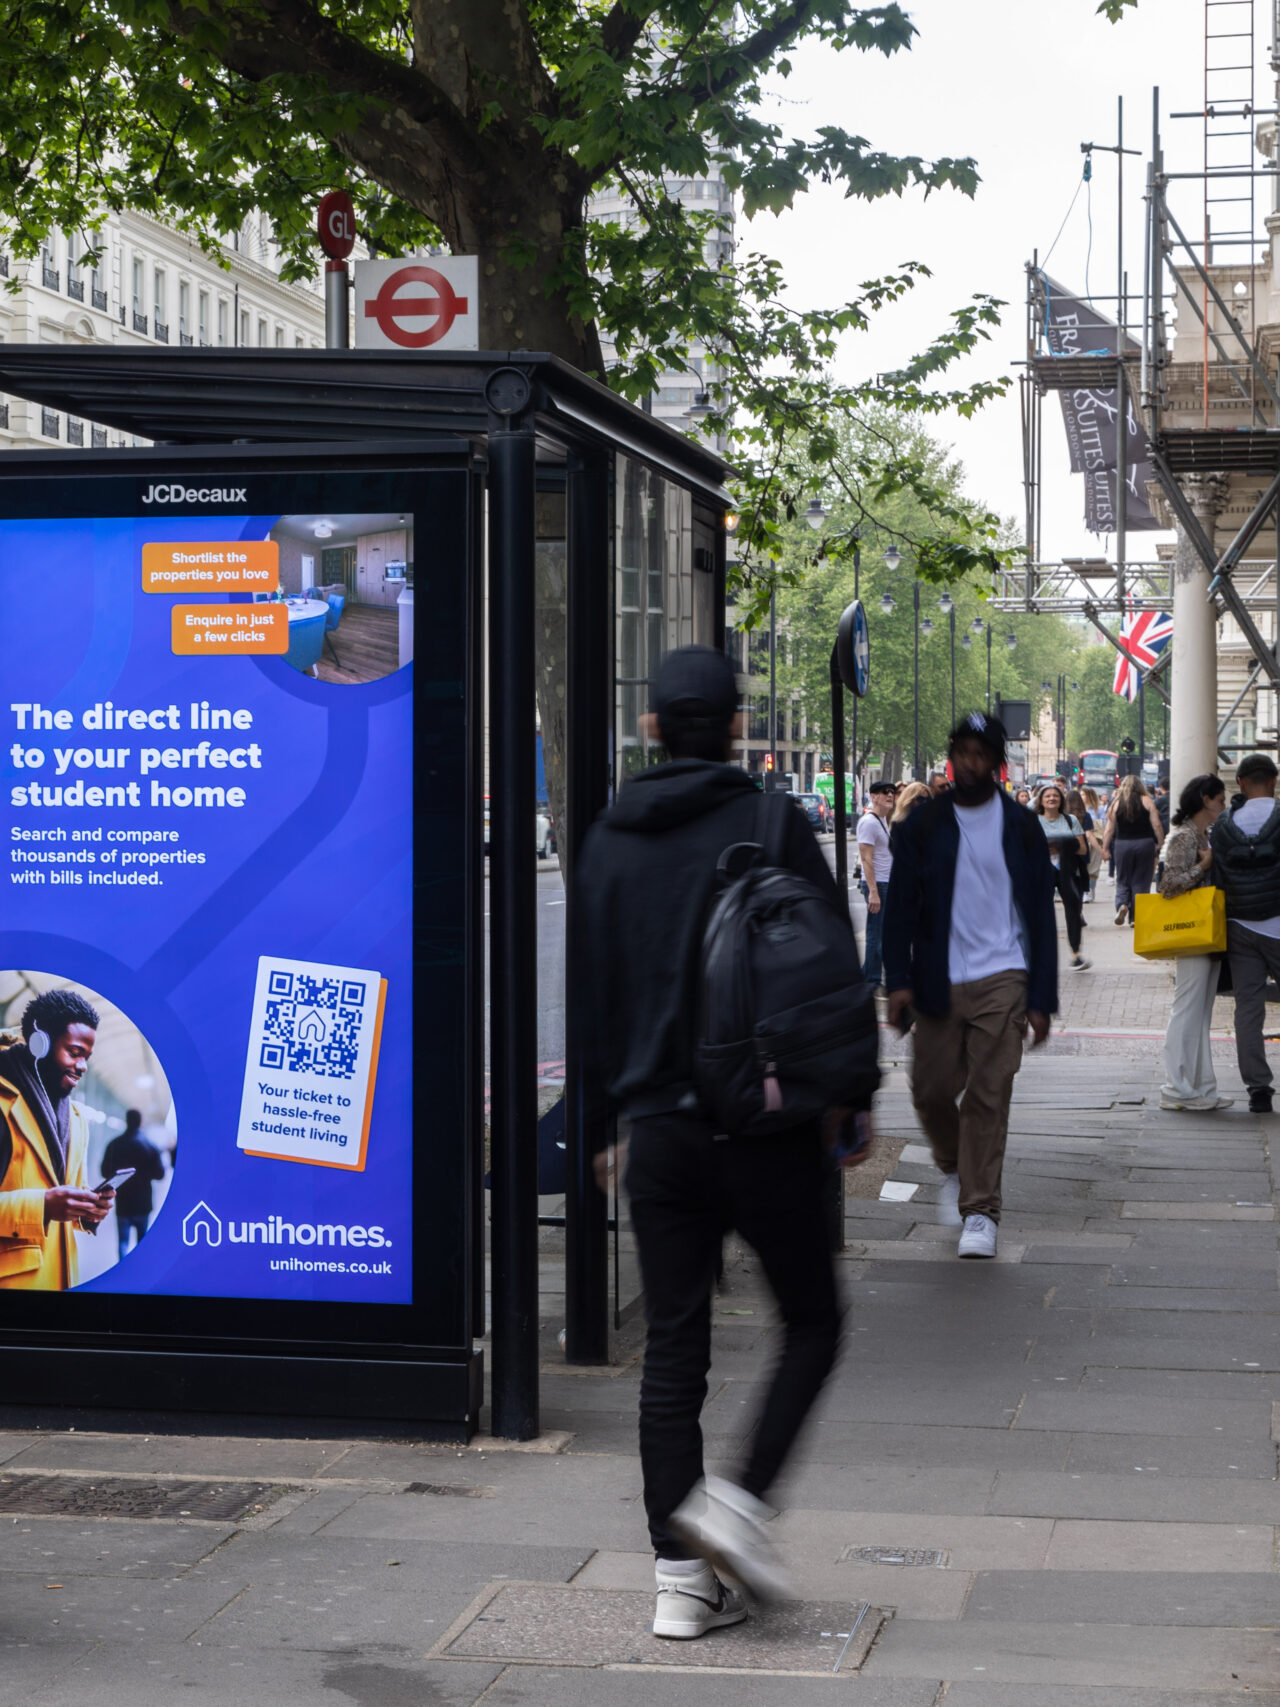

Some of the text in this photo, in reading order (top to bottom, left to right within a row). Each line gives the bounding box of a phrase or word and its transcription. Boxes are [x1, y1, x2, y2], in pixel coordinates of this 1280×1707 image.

[329, 211, 352, 240] GL
[142, 485, 246, 503] JCDecaux
[172, 552, 247, 563] Shortlist the
[151, 568, 269, 583] properties you love
[186, 614, 274, 628] Enquire in just
[194, 631, 265, 642] a few clicks
[11, 701, 252, 730] The direct line
[10, 741, 261, 775] to your perfect
[11, 780, 246, 807] student home
[11, 827, 179, 844] Search and compare
[11, 849, 205, 866] thousands of properties
[11, 870, 163, 885] with bills included.
[258, 1082, 351, 1107] Your ticket to
[263, 1101, 341, 1124] hassle-free
[251, 1120, 347, 1146] student living
[229, 1215, 392, 1247] unihomes.
[271, 1258, 391, 1274] unihomes.co.uk
